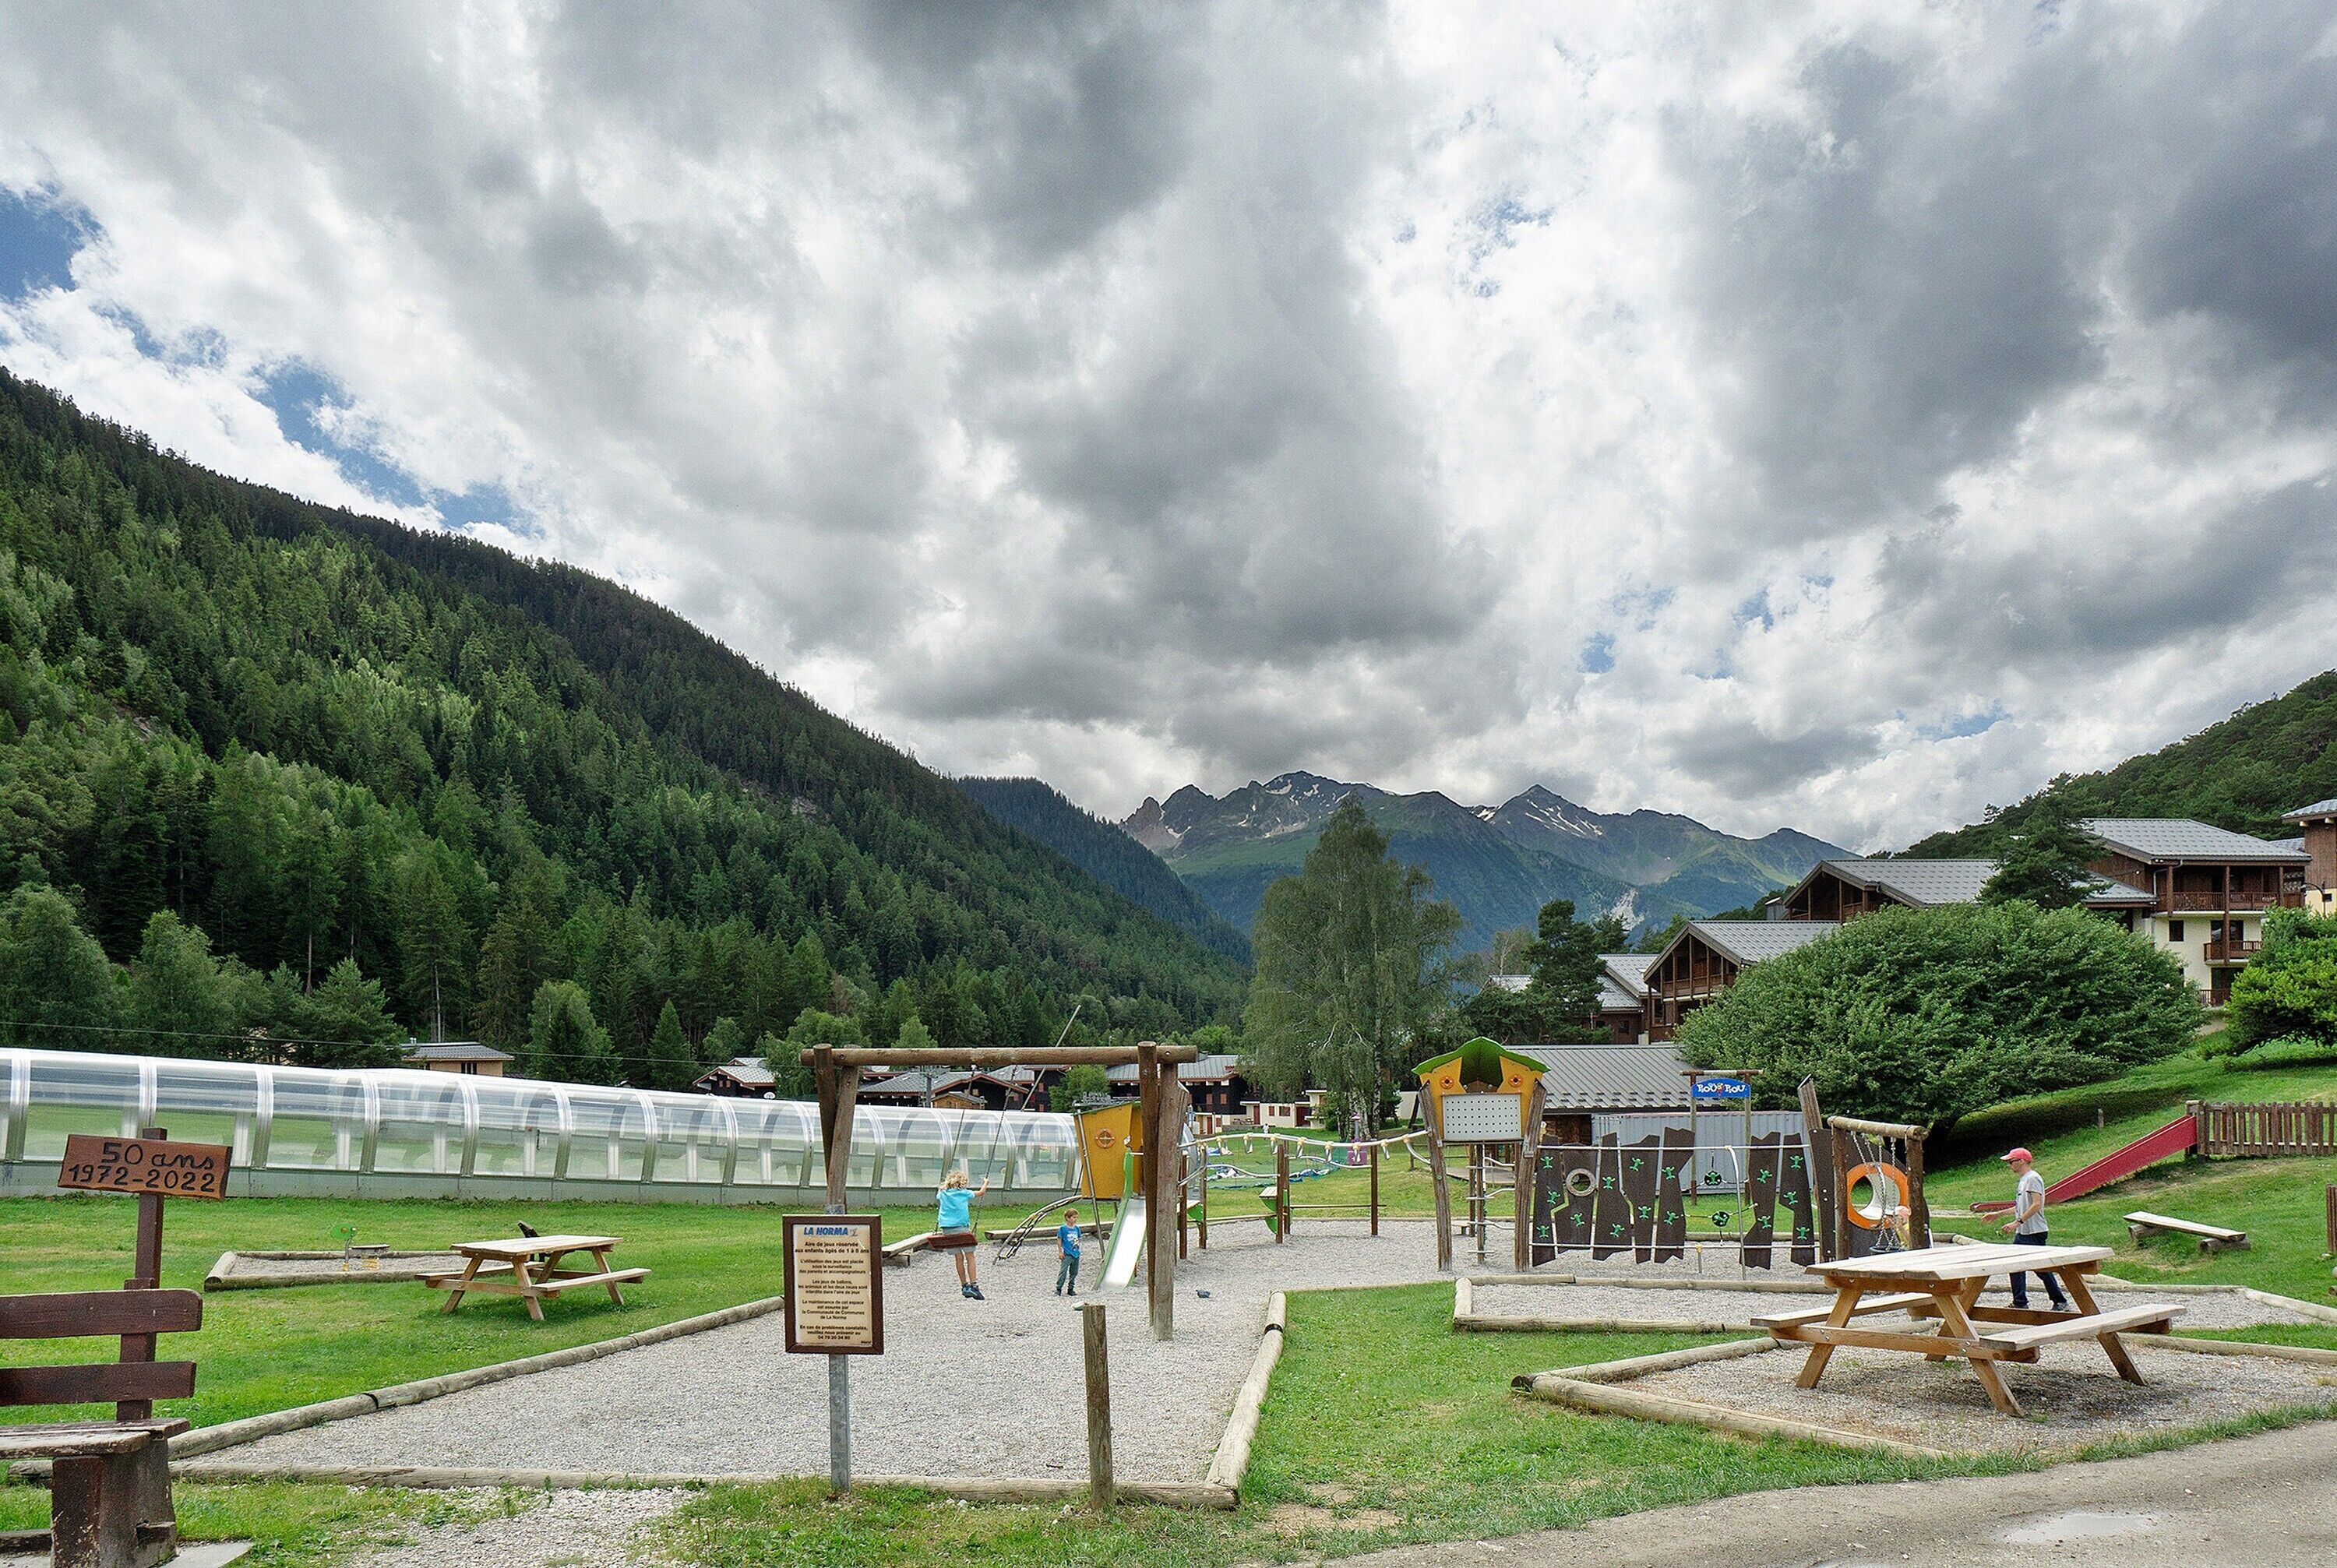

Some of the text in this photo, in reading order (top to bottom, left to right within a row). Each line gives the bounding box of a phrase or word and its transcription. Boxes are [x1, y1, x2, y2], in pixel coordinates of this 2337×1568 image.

[100, 1142, 214, 1171] 50 ans
[68, 1164, 215, 1193] 1972-2022
[803, 1227, 848, 1236] LA NORMA
